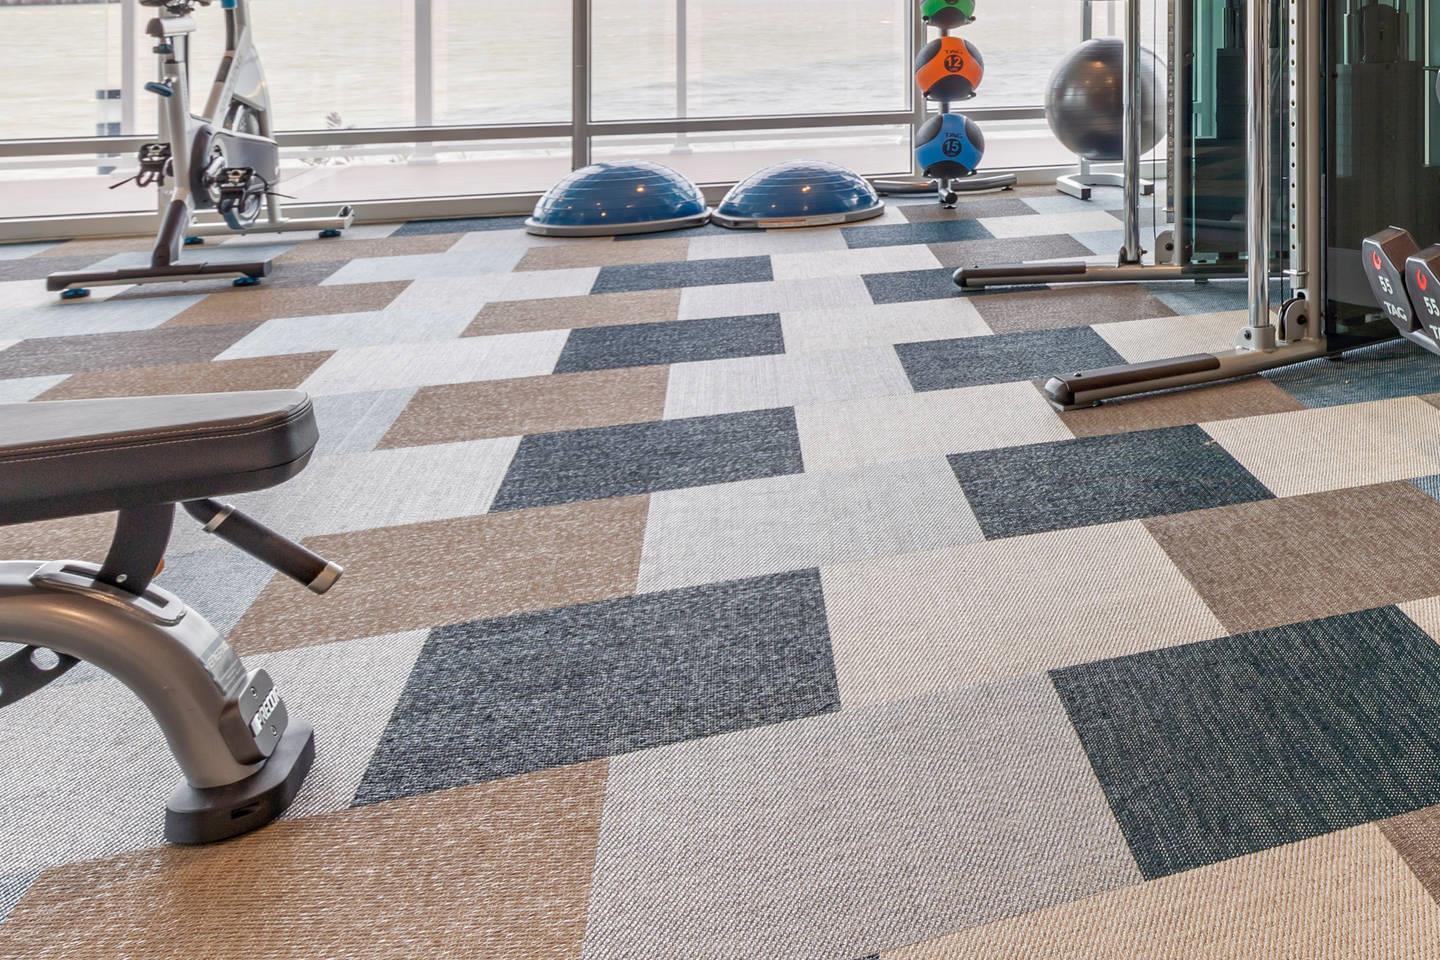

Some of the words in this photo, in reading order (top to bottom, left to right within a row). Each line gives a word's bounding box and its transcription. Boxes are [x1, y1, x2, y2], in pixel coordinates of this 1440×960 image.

[947, 57, 961, 68] 12
[945, 141, 960, 152] 15
[1378, 276, 1393, 294] 55
[1384, 301, 1407, 322] TAG
[1423, 296, 1440, 316] 55
